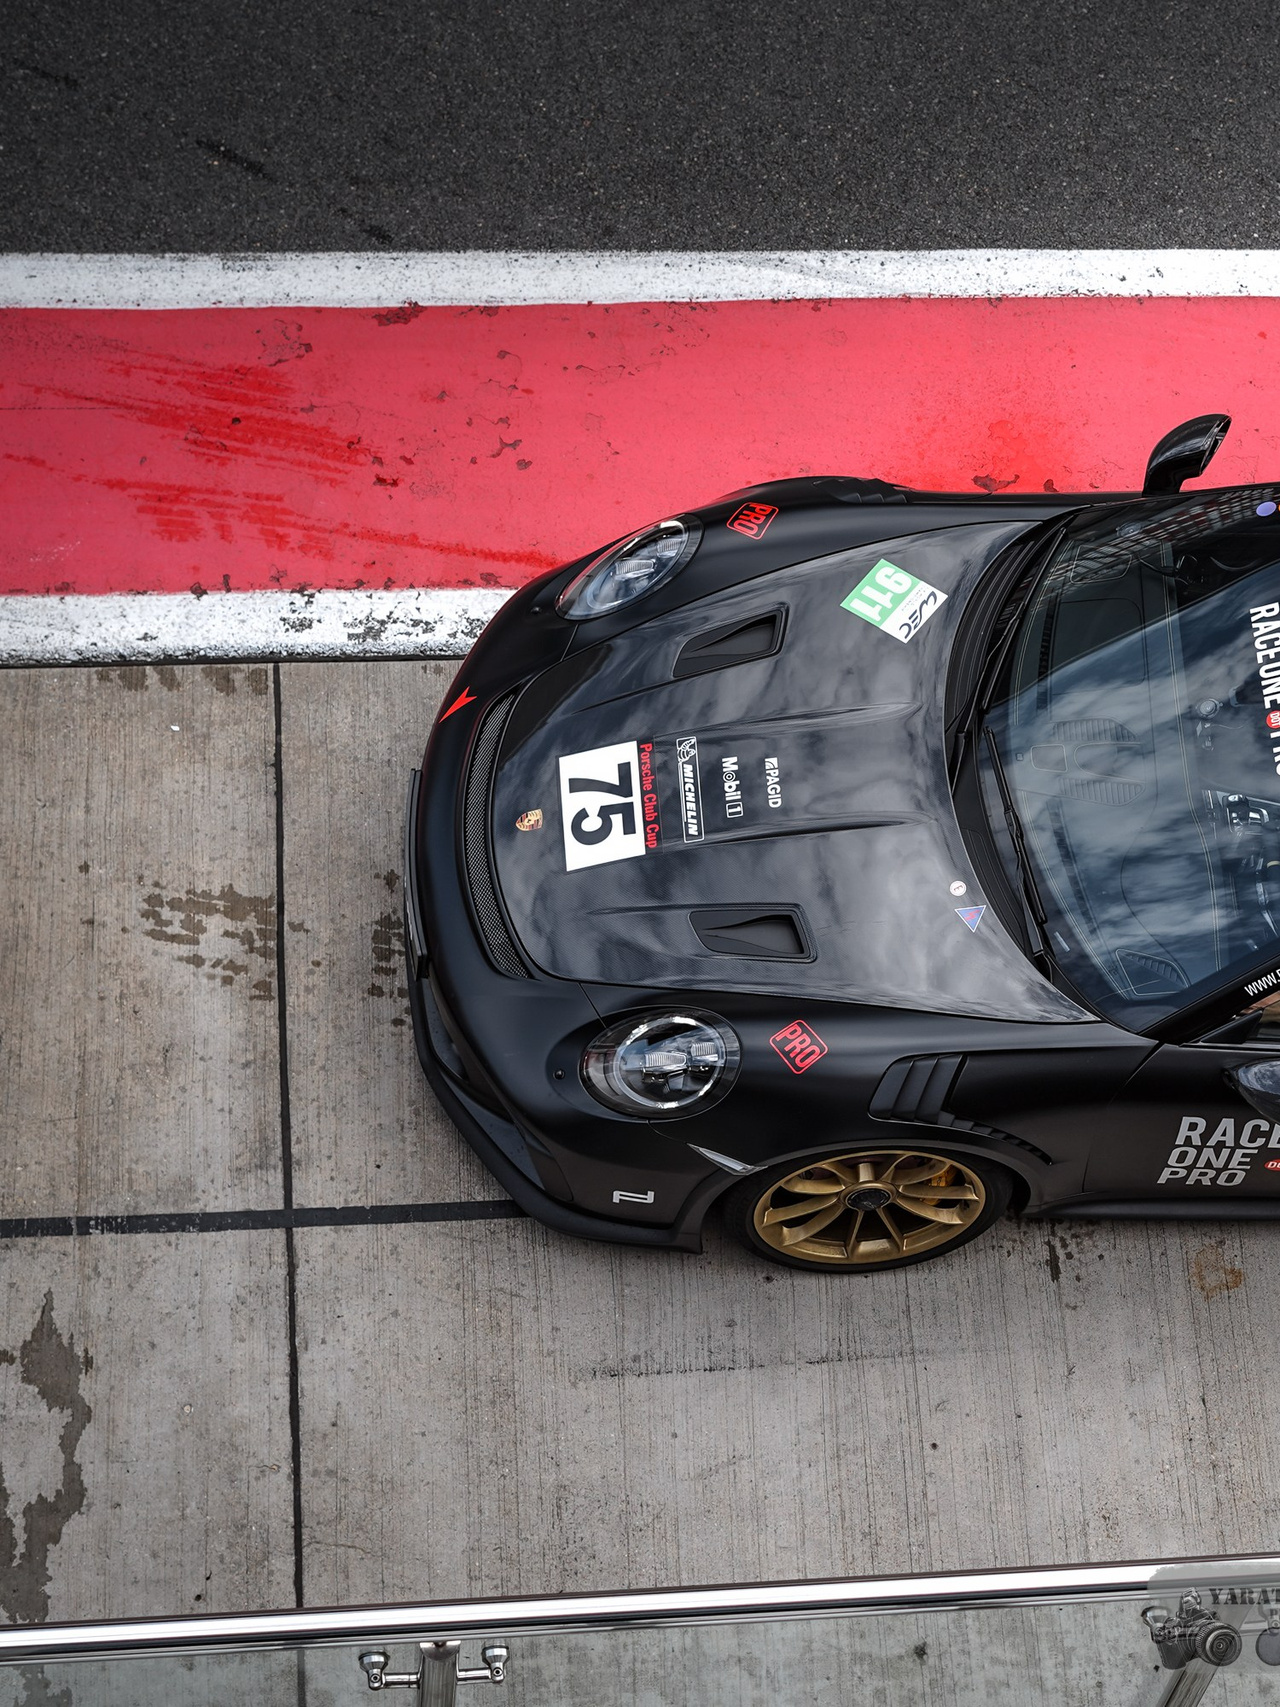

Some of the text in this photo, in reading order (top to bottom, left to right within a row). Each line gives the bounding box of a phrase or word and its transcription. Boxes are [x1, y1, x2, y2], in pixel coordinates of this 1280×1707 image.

[733, 503, 772, 534] PRO
[849, 566, 912, 621] 911
[898, 590, 937, 639] WEC
[640, 743, 657, 848] Porsche Club Cup
[683, 763, 698, 835] MICHELIN
[722, 756, 741, 800] Mobil
[766, 767, 782, 808] PAGID
[568, 761, 636, 845] 75
[775, 1023, 820, 1067] PRO
[1156, 1167, 1246, 1186] PRO
[1167, 1146, 1258, 1169] ONE
